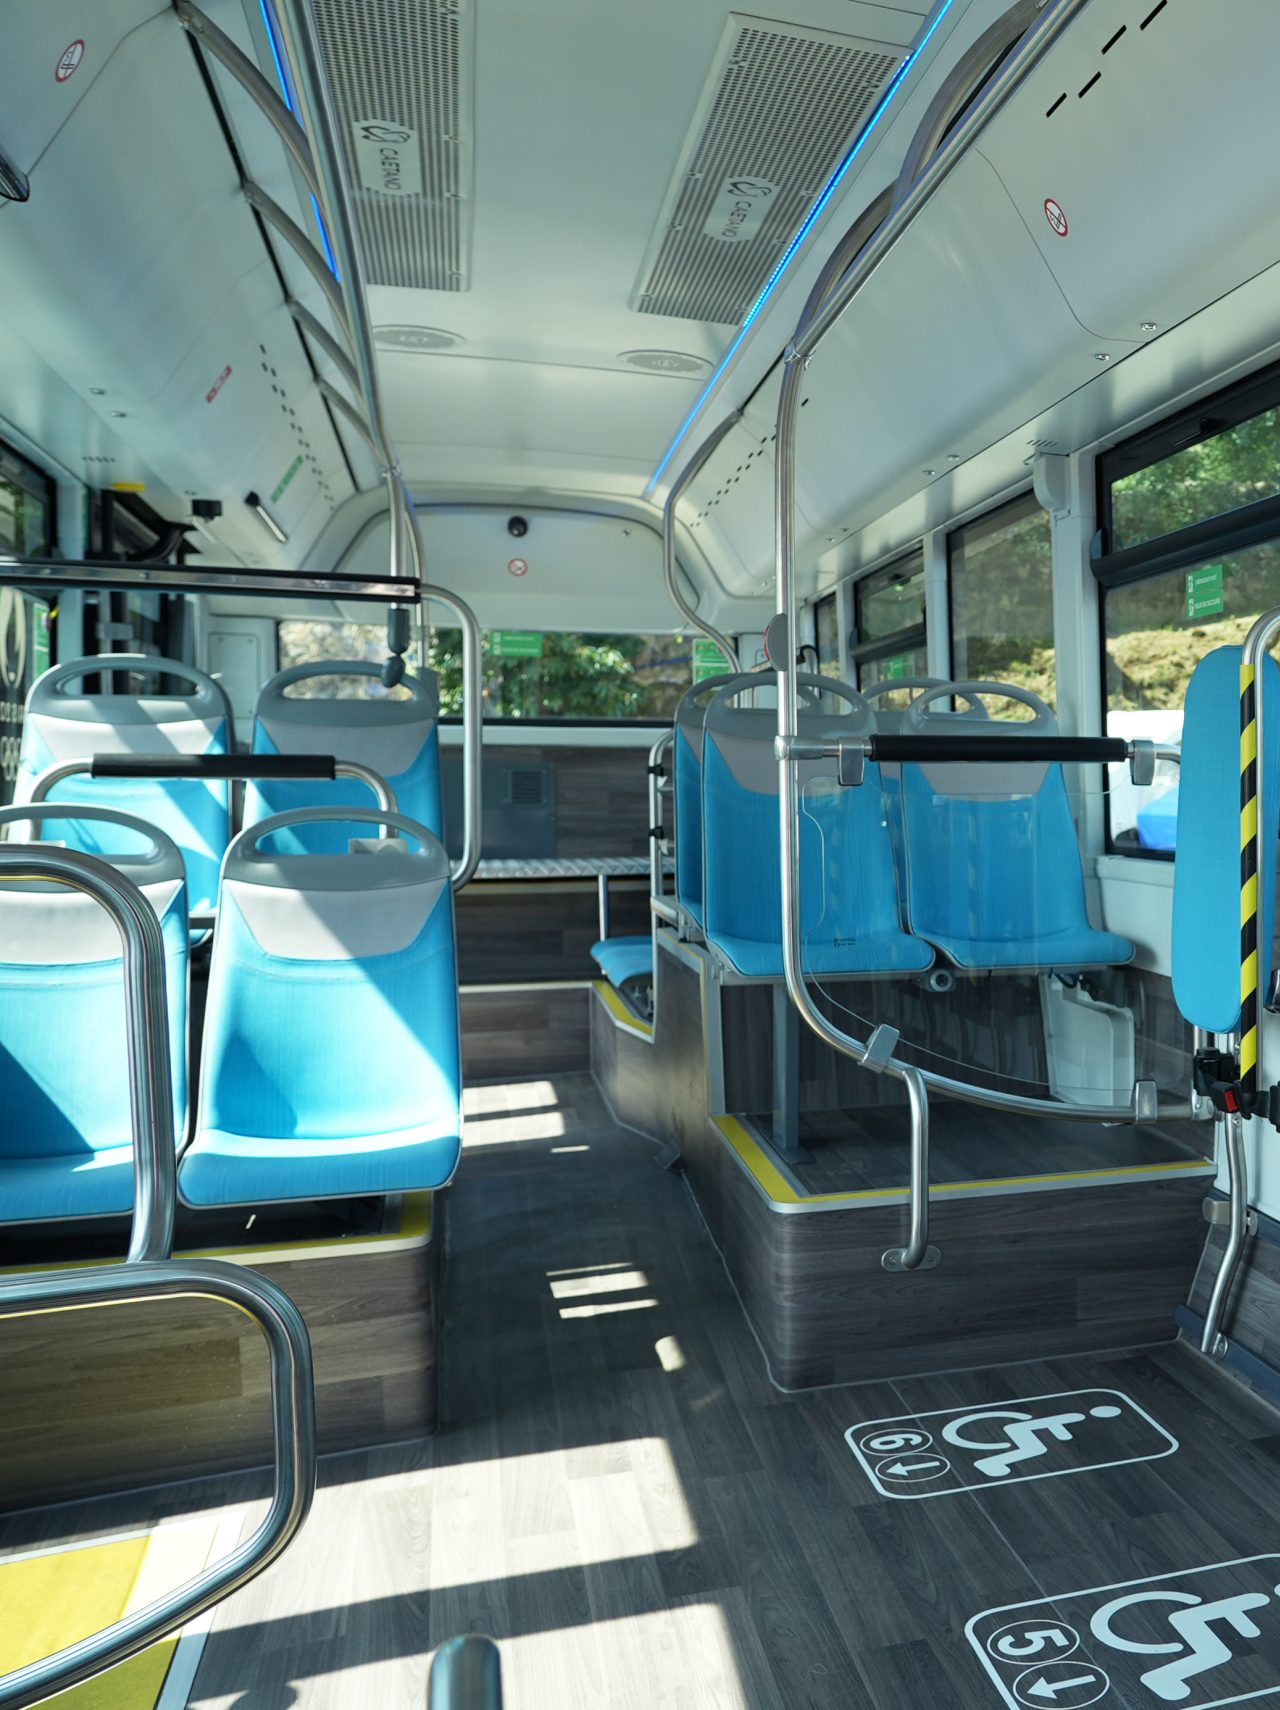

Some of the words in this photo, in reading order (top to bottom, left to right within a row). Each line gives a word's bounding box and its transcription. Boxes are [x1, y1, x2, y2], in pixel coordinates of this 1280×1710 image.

[380, 148, 401, 190] CAETANO
[722, 201, 752, 237] CAETANO
[870, 1434, 922, 1450] 6
[998, 1629, 1069, 1655] 5
